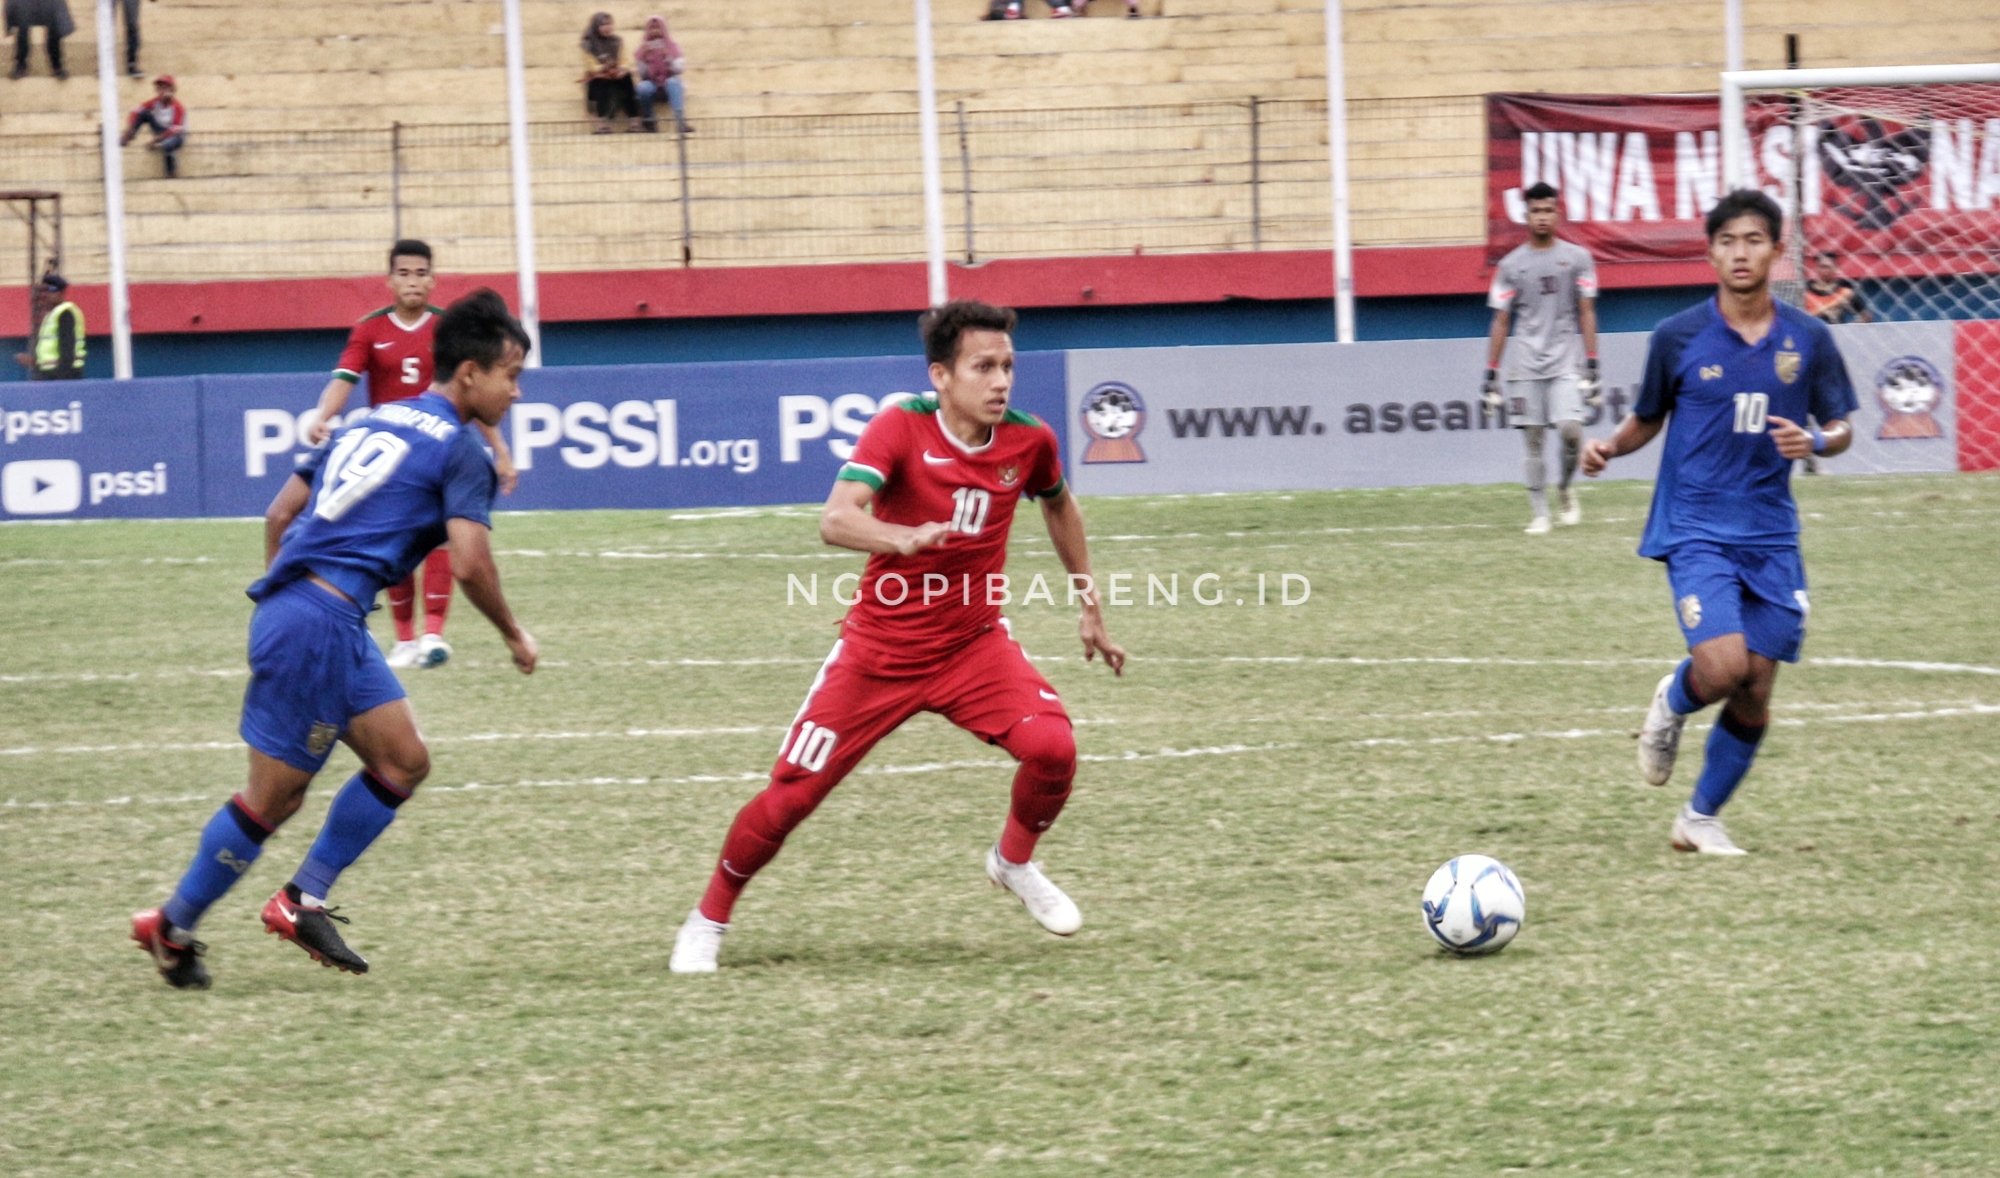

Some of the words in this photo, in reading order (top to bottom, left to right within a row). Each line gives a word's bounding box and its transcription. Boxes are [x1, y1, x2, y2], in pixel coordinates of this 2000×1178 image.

[1503, 131, 1663, 224] JIWA
[400, 357, 420, 384] 5
[1165, 405, 1327, 439] www.
[1733, 392, 1769, 434] 10
[89, 462, 168, 505] pssi
[313, 426, 411, 522] 19
[951, 486, 991, 535] 10
[785, 719, 838, 773] 10
